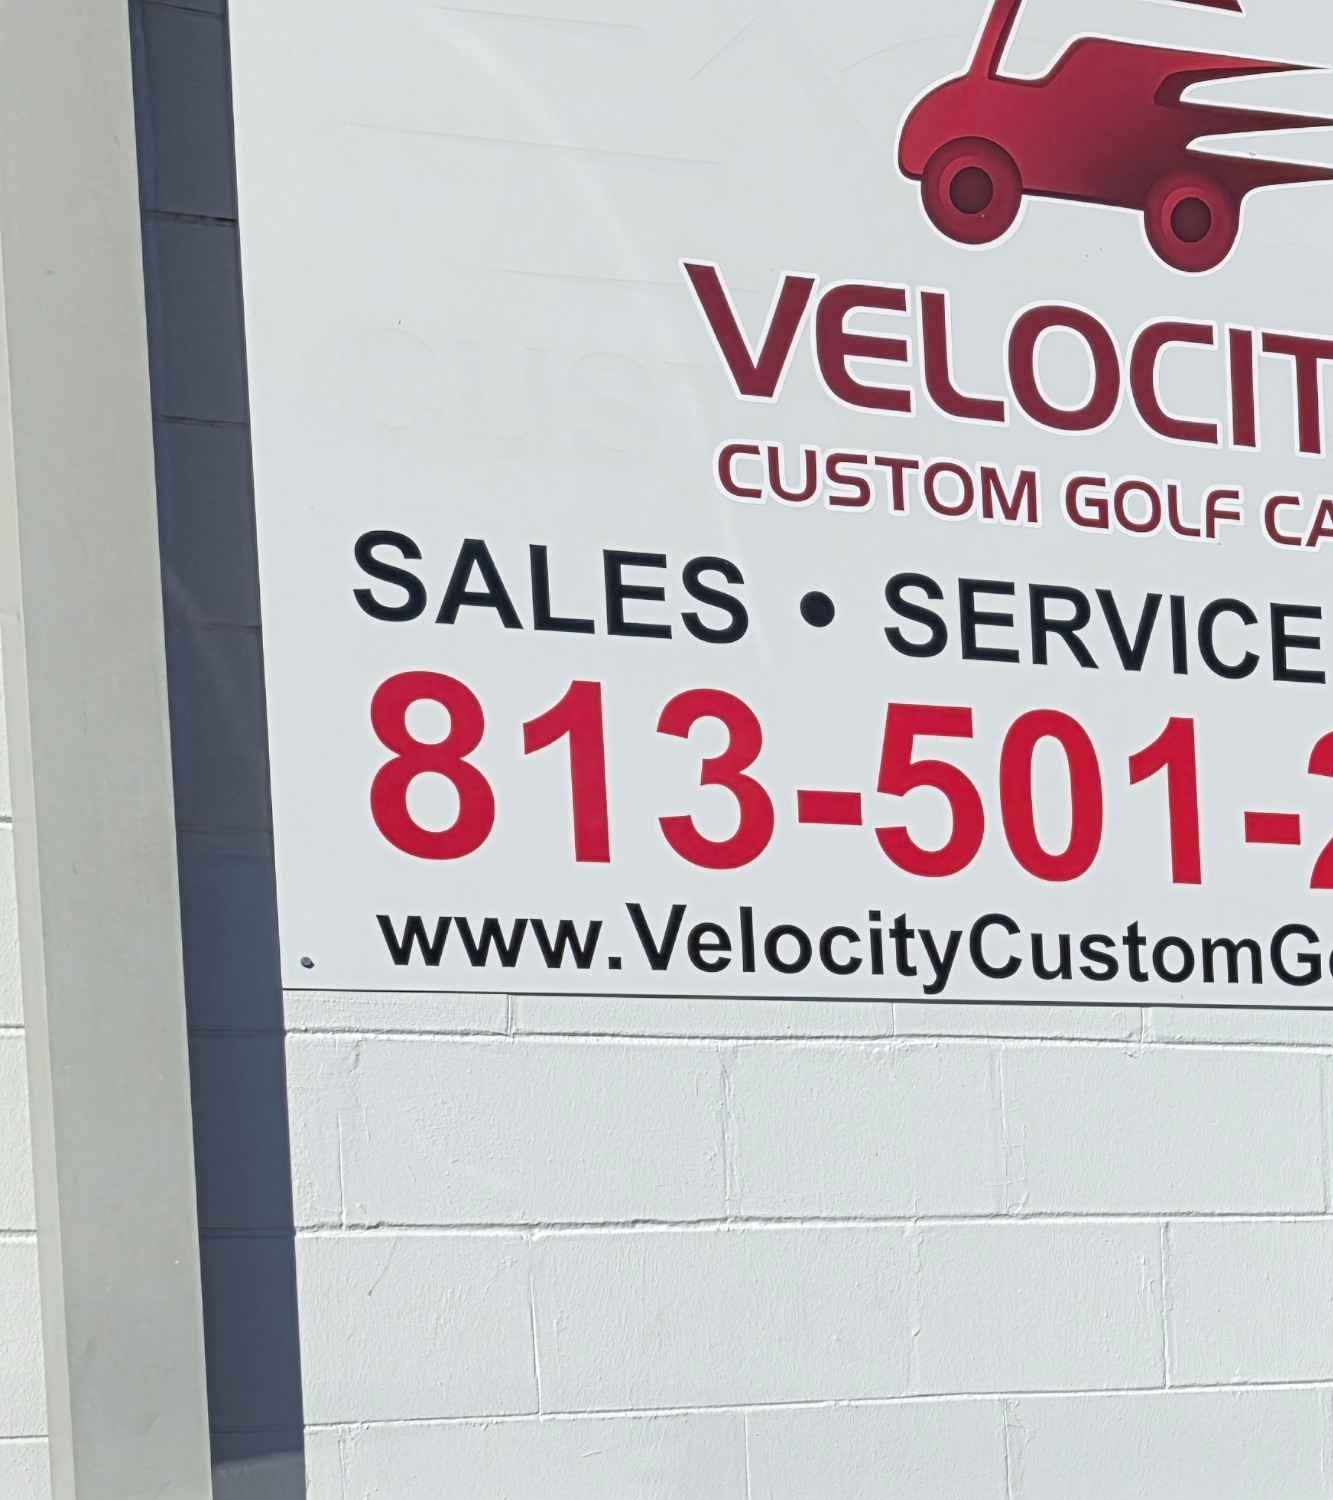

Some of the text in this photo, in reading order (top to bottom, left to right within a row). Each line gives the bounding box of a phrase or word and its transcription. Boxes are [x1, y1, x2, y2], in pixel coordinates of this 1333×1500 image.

[717, 444, 1039, 525] CUSTOM
[1065, 475, 1241, 539] GOLF
[352, 529, 750, 645] SALES
[884, 572, 1327, 685] SERVICE
